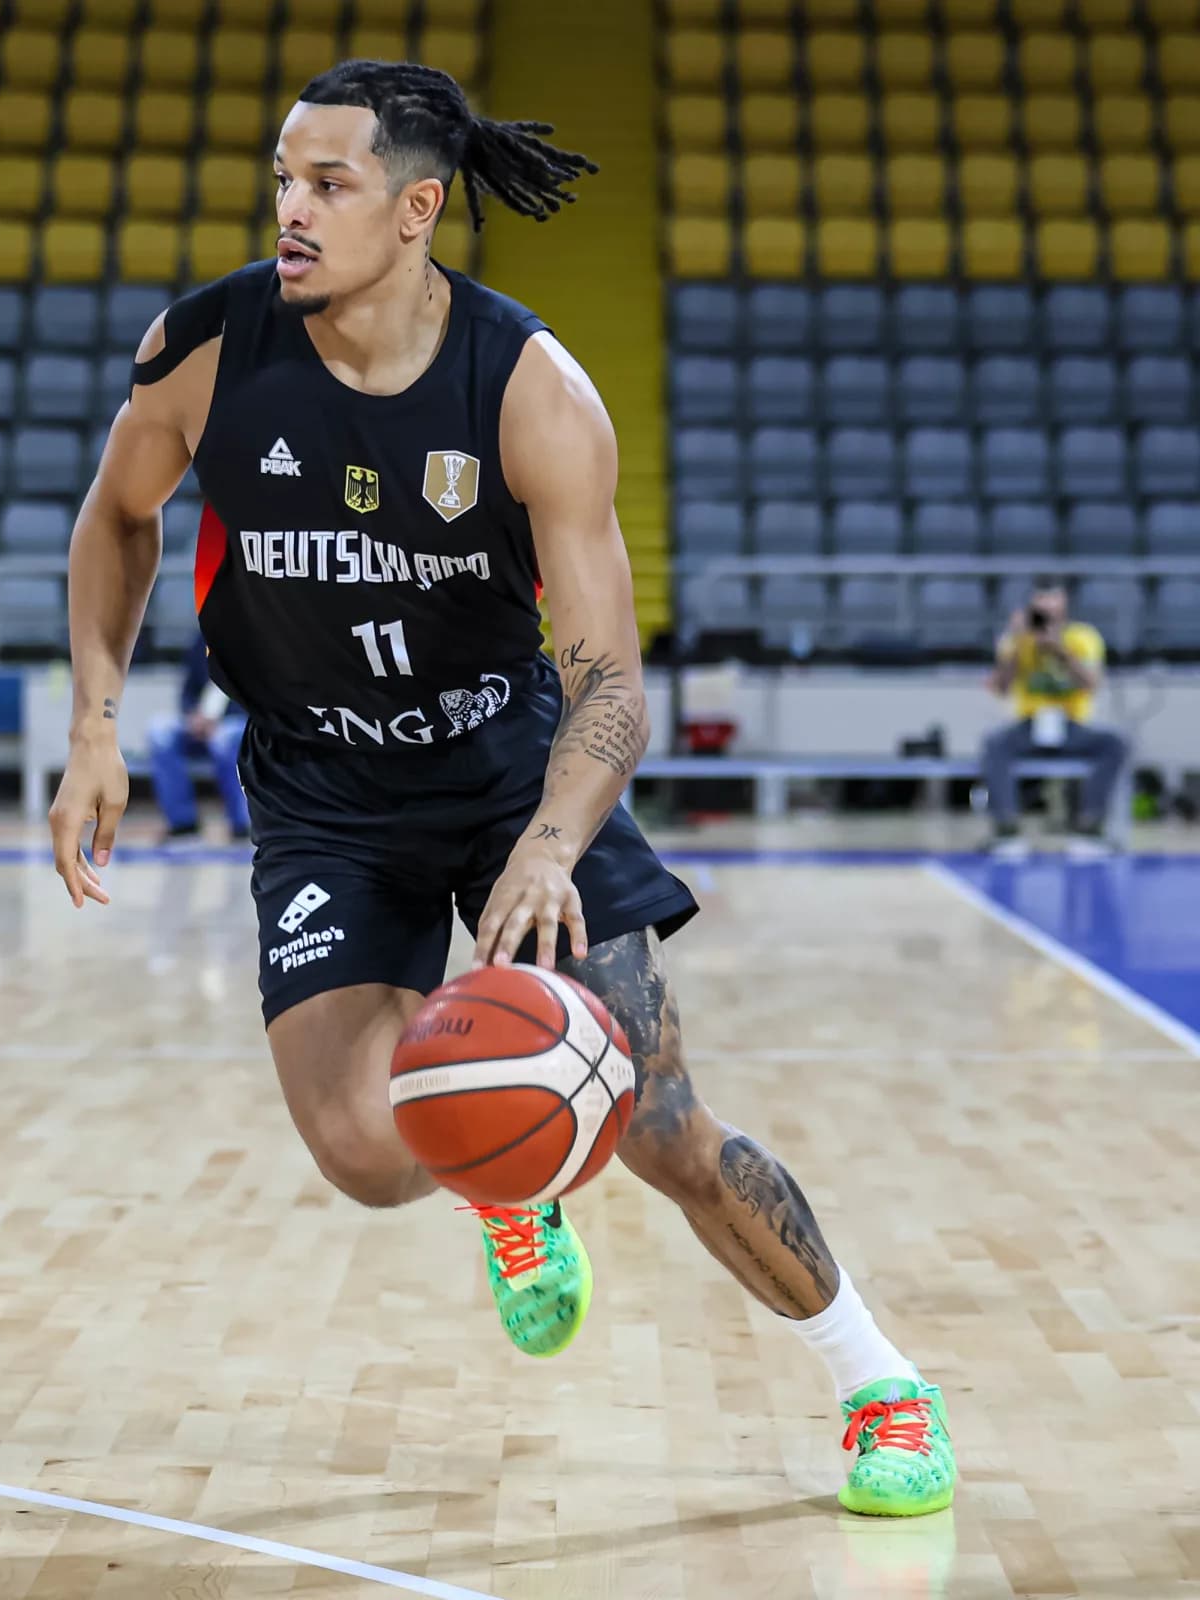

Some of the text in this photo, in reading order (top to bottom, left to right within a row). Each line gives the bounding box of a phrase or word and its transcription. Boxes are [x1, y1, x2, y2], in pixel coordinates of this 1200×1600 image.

[260, 457, 302, 477] PEAK
[351, 619, 414, 678] 11
[561, 639, 594, 669] CK
[268, 926, 345, 966] Domino's
